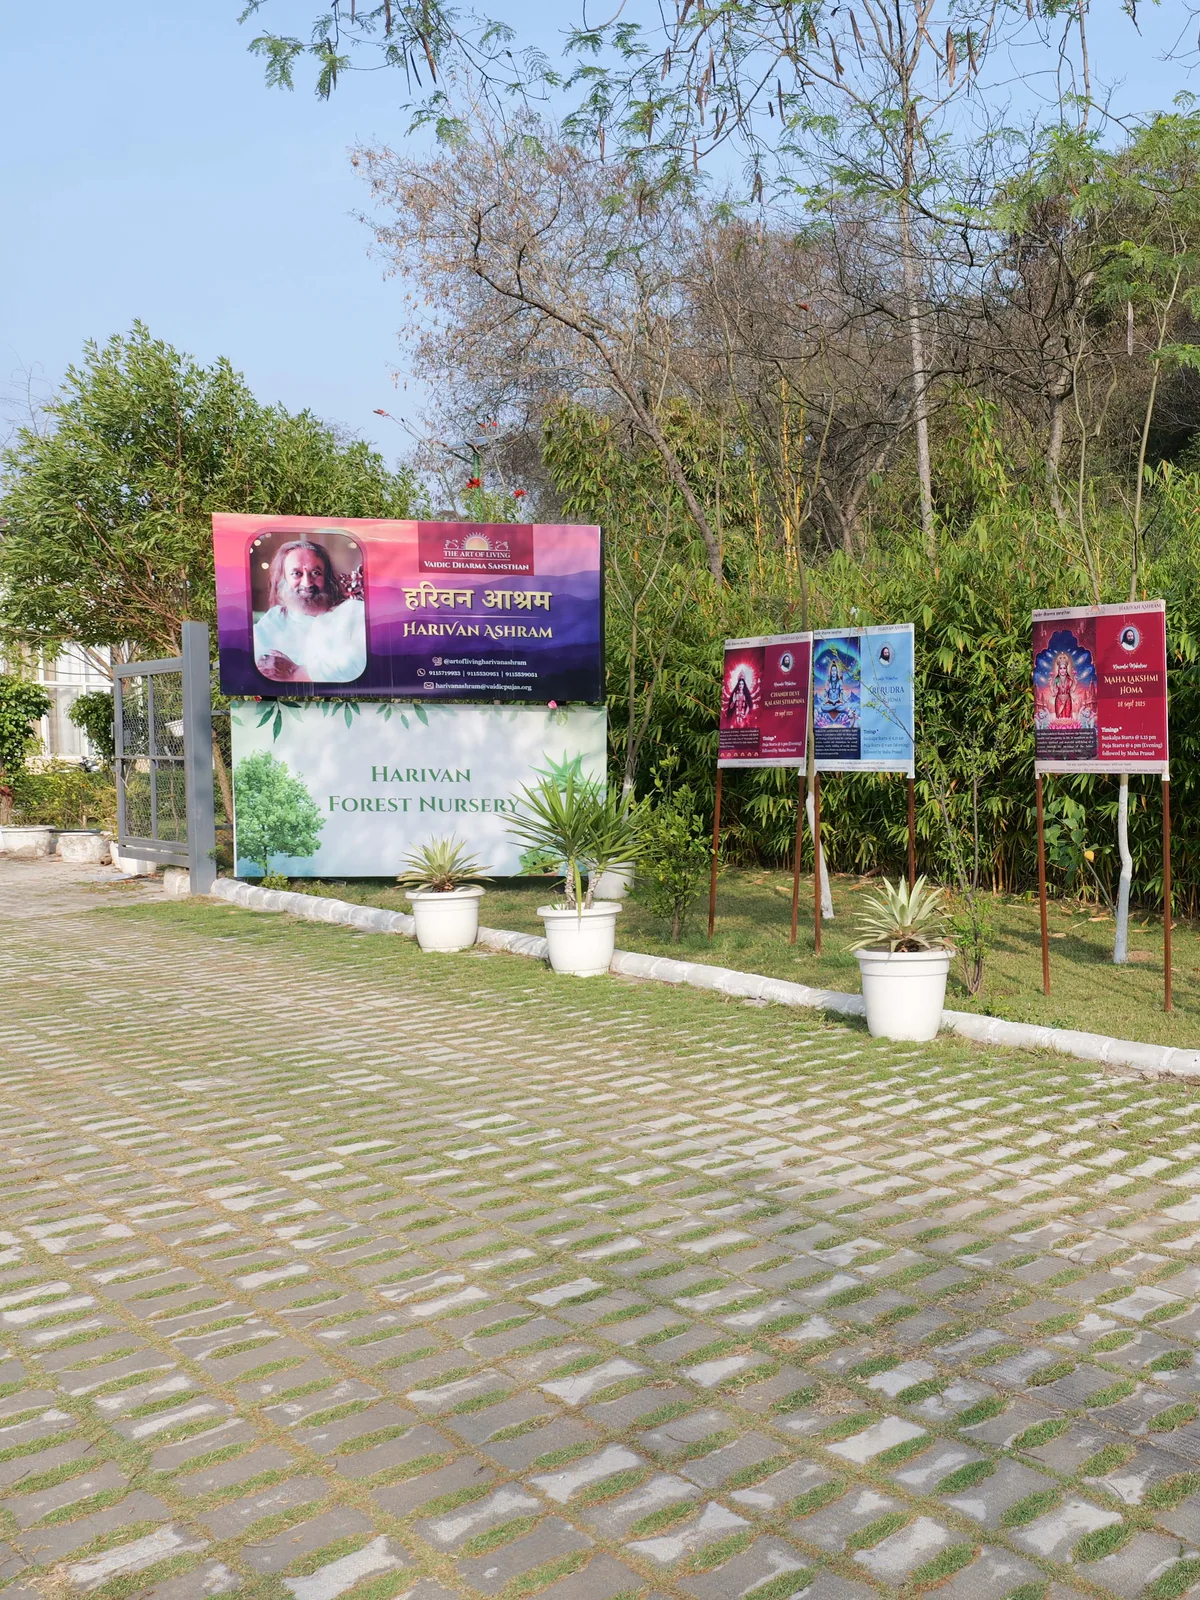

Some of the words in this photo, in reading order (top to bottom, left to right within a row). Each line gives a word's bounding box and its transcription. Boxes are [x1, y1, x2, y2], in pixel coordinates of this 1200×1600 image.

[400, 580, 475, 611] हरिवन
[482, 590, 552, 611] आश्रम
[403, 621, 480, 637] HARIVAN
[484, 624, 553, 640] ASHRAM
[1104, 676, 1126, 684] MAHA
[1128, 675, 1158, 684] LAKSHMI
[1120, 686, 1143, 695] HOMA
[371, 765, 471, 783] HARIVAN
[328, 795, 412, 812] FOREST
[419, 796, 520, 813] NURSERY
